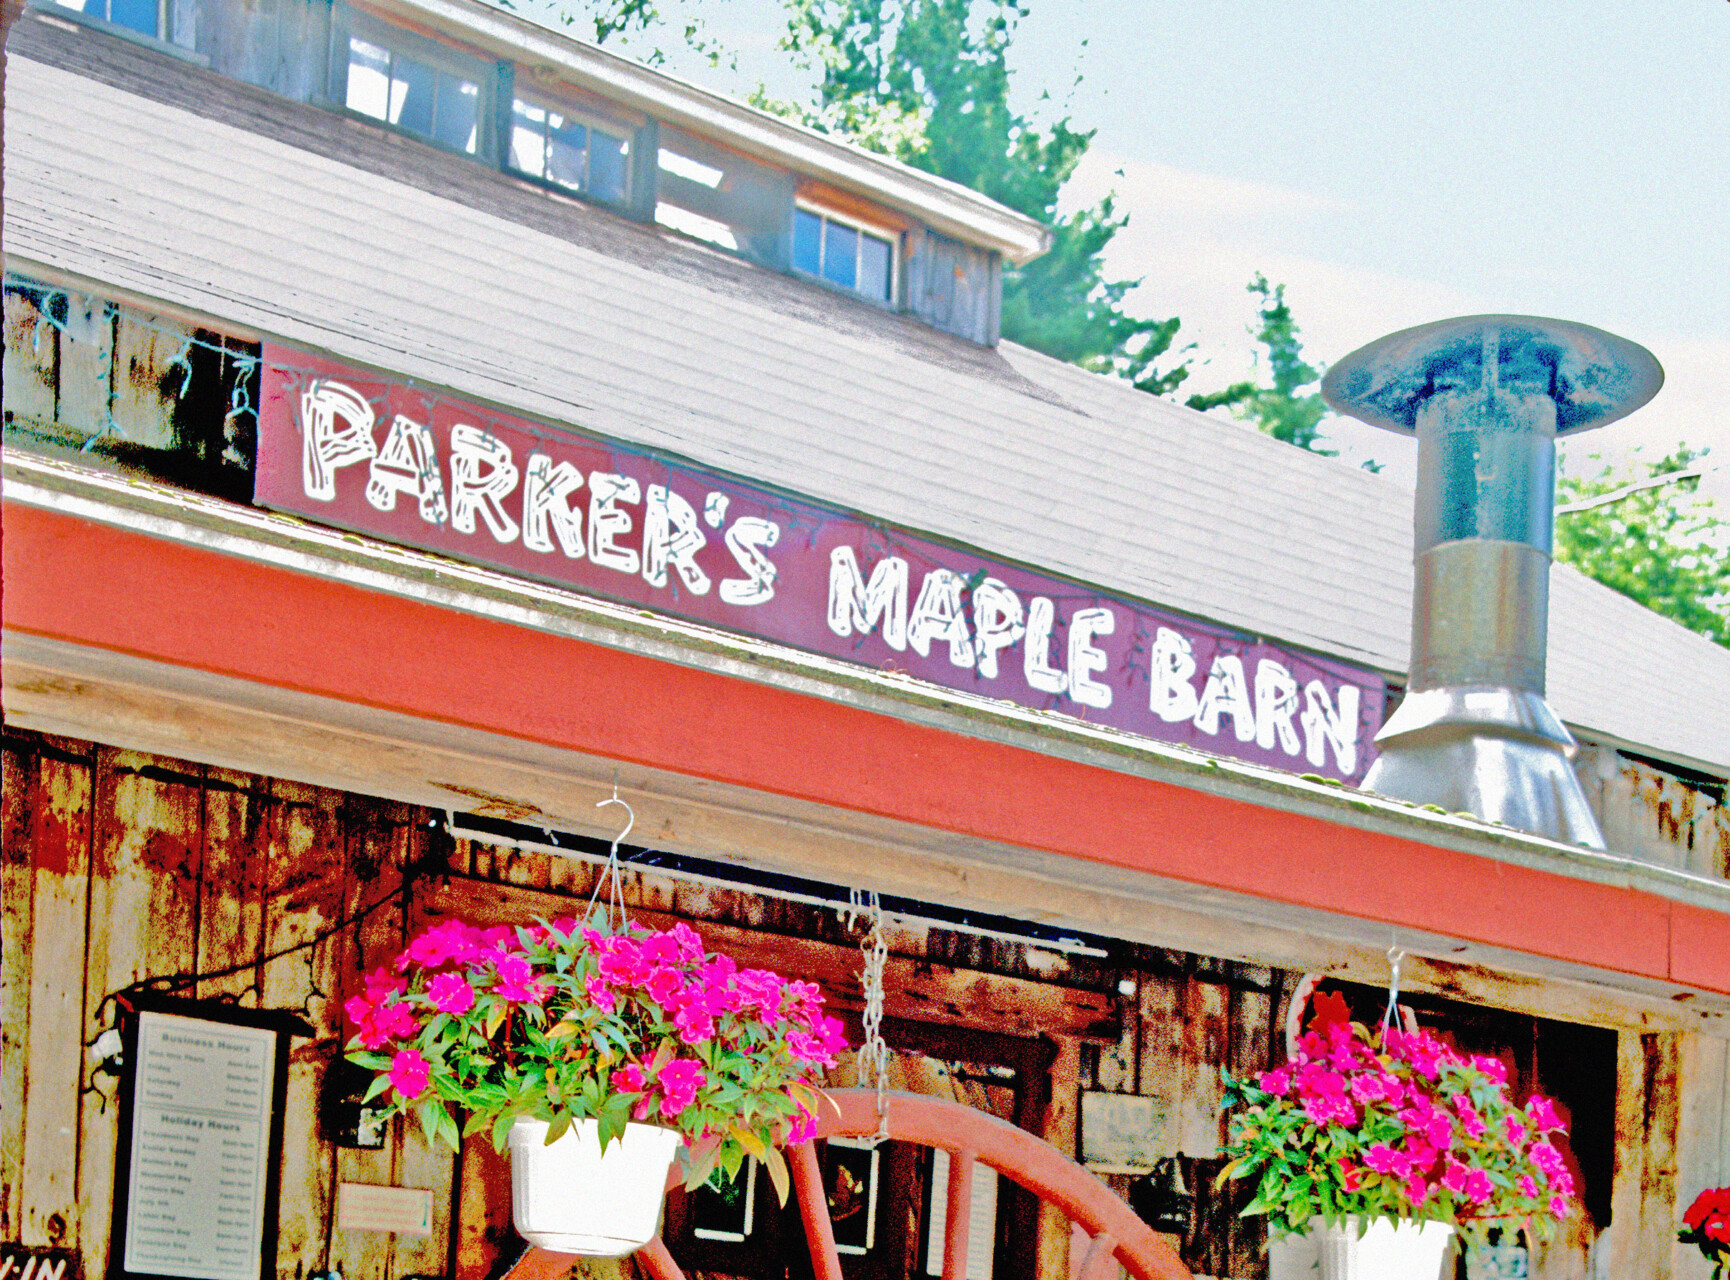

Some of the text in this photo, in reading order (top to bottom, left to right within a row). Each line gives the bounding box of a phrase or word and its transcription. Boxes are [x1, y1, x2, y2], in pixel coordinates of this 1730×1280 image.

[302, 379, 1361, 776] PARKER'S MAPLE BARN
[161, 1032, 251, 1053] Business Hours
[160, 1113, 241, 1132] Holiday Hours
